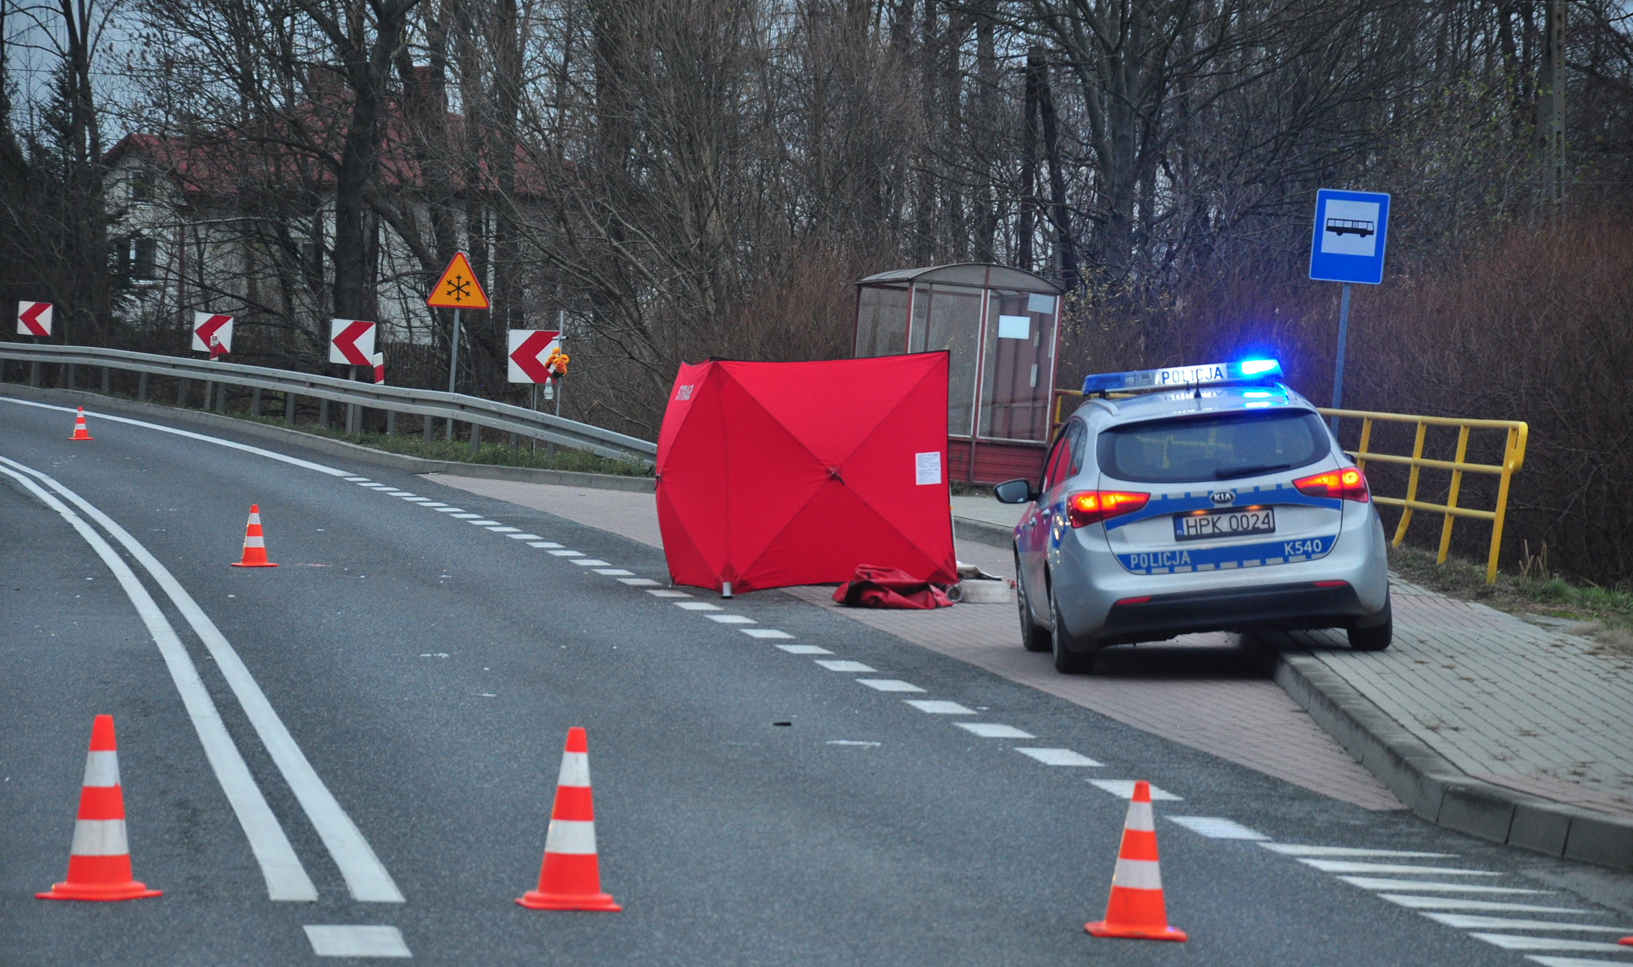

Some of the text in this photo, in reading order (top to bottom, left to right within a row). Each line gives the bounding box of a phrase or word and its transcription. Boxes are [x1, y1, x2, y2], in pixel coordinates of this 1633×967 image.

[1161, 366, 1224, 384] POLICJA
[1213, 493, 1232, 502] KIA
[1186, 516, 1224, 535] HPK
[1229, 512, 1271, 532] 0024
[1284, 539, 1322, 555] K540
[1130, 550, 1191, 568] POLICJA
